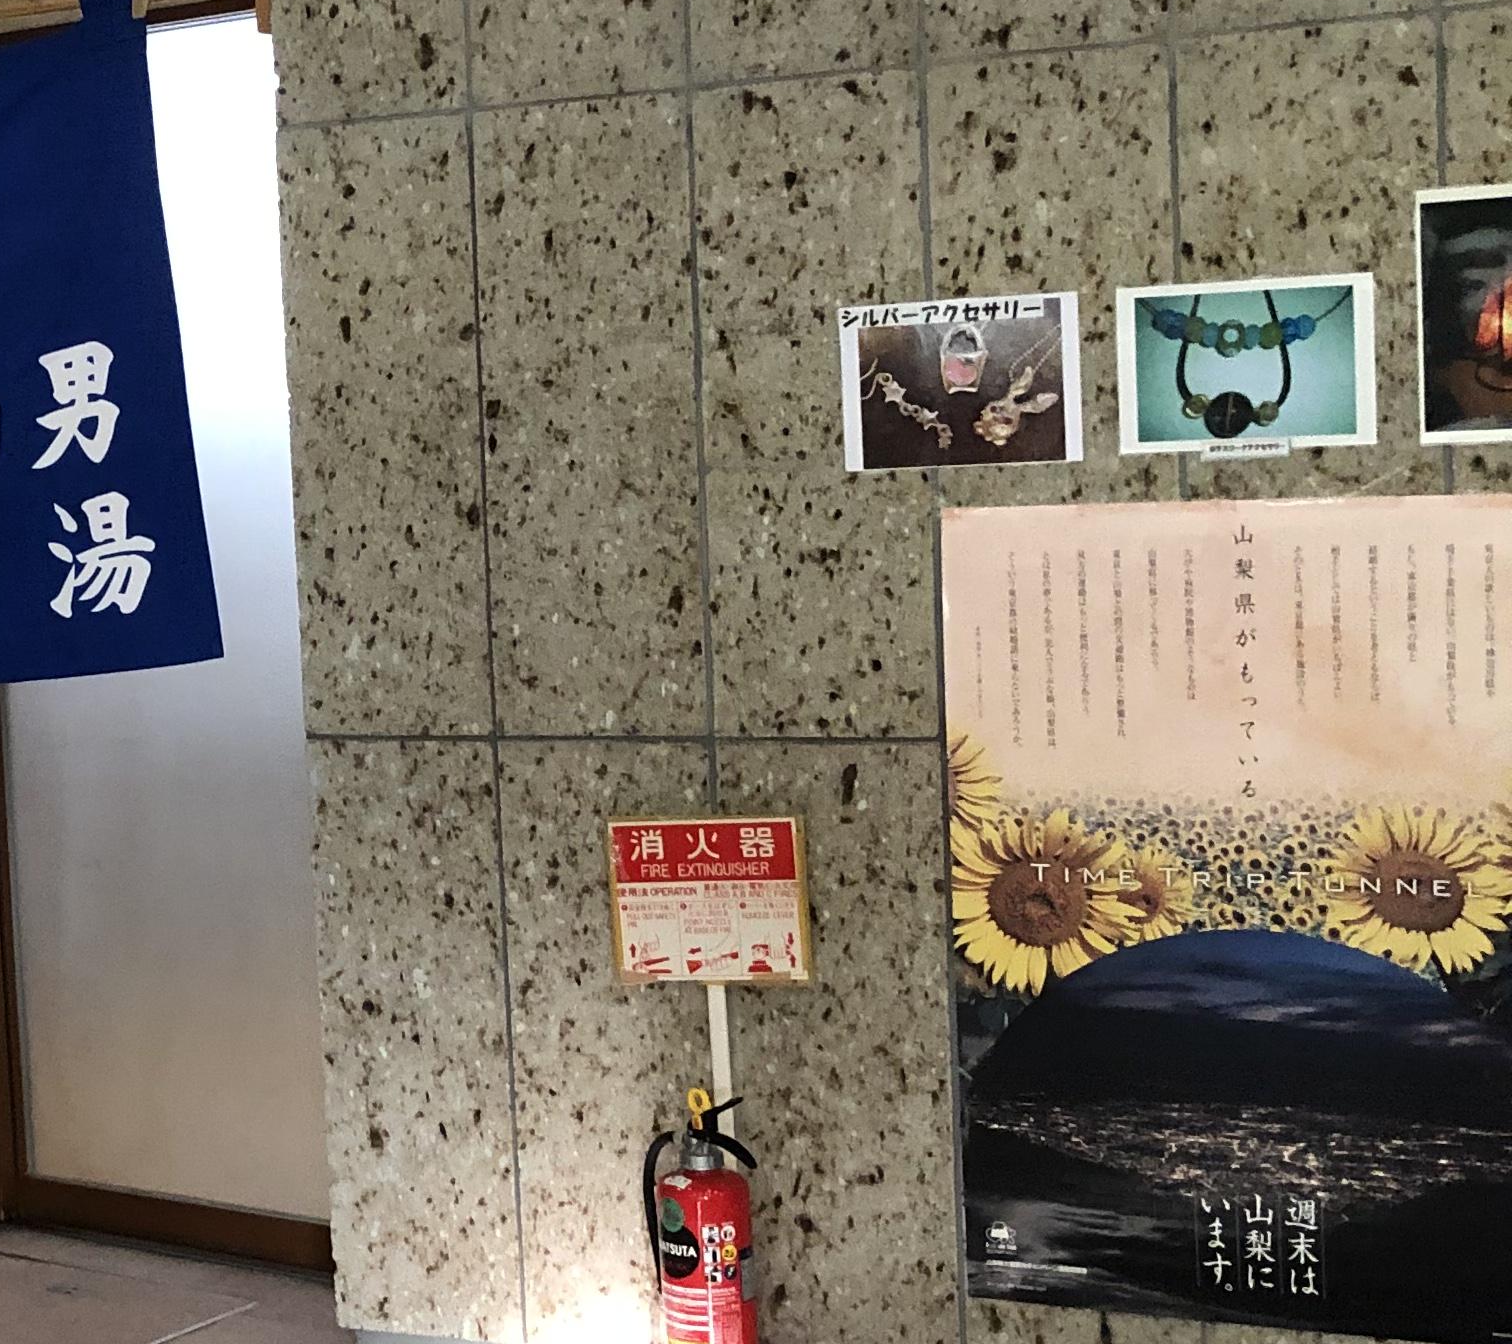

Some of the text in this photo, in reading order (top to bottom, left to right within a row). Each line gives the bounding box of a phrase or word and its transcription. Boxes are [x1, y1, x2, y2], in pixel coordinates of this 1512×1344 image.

[840, 299, 1042, 328] シルバーアクセサリー
[31, 340, 156, 618] 男湯
[1232, 524, 1261, 800] 山梨県がもっている
[630, 827, 776, 861] 消火器
[640, 862, 770, 878] FIRE EXTINGUISHER
[1030, 862, 1483, 898] TIME TRIP TUNNEL
[1200, 1197, 1234, 1292] います。
[1243, 1193, 1276, 1289] 山梨に
[1284, 1196, 1319, 1296] 週末は
